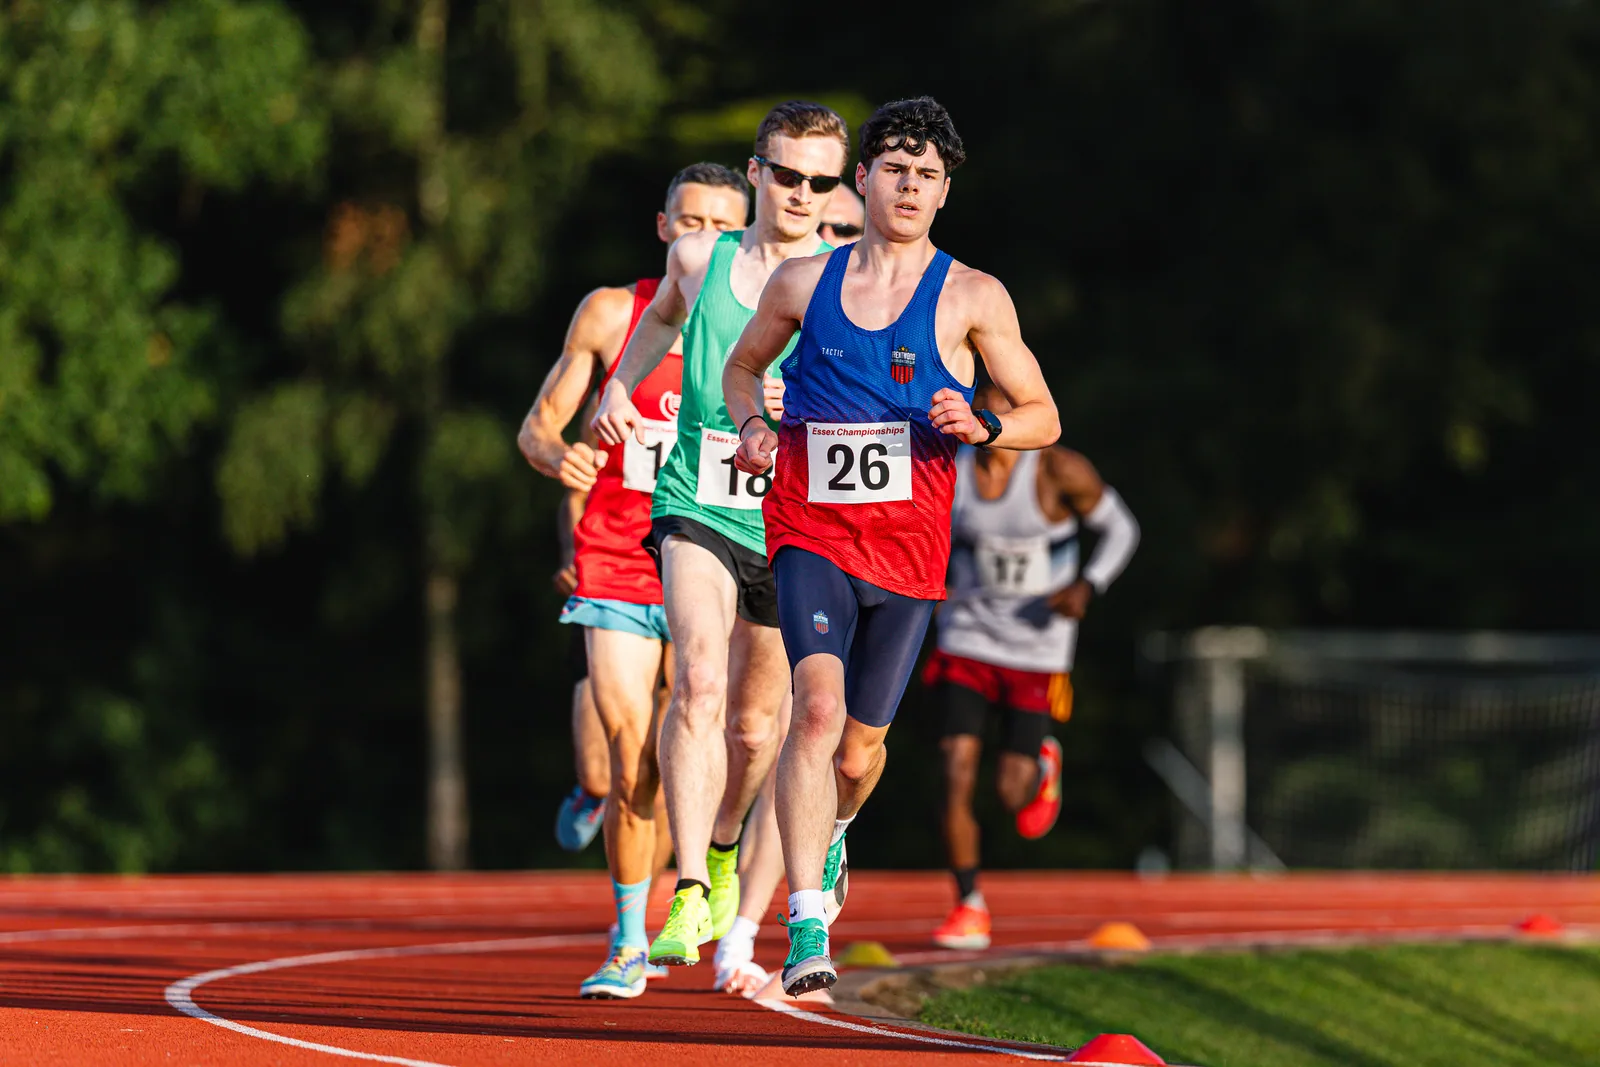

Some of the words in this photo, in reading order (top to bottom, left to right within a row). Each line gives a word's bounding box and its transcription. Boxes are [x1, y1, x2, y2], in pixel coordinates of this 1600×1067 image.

[821, 347, 844, 358] TACTIC
[811, 427, 835, 436] Essex
[836, 426, 905, 437] Championships
[706, 433, 729, 444] Essex
[646, 441, 663, 481] 1
[826, 442, 890, 491] 26
